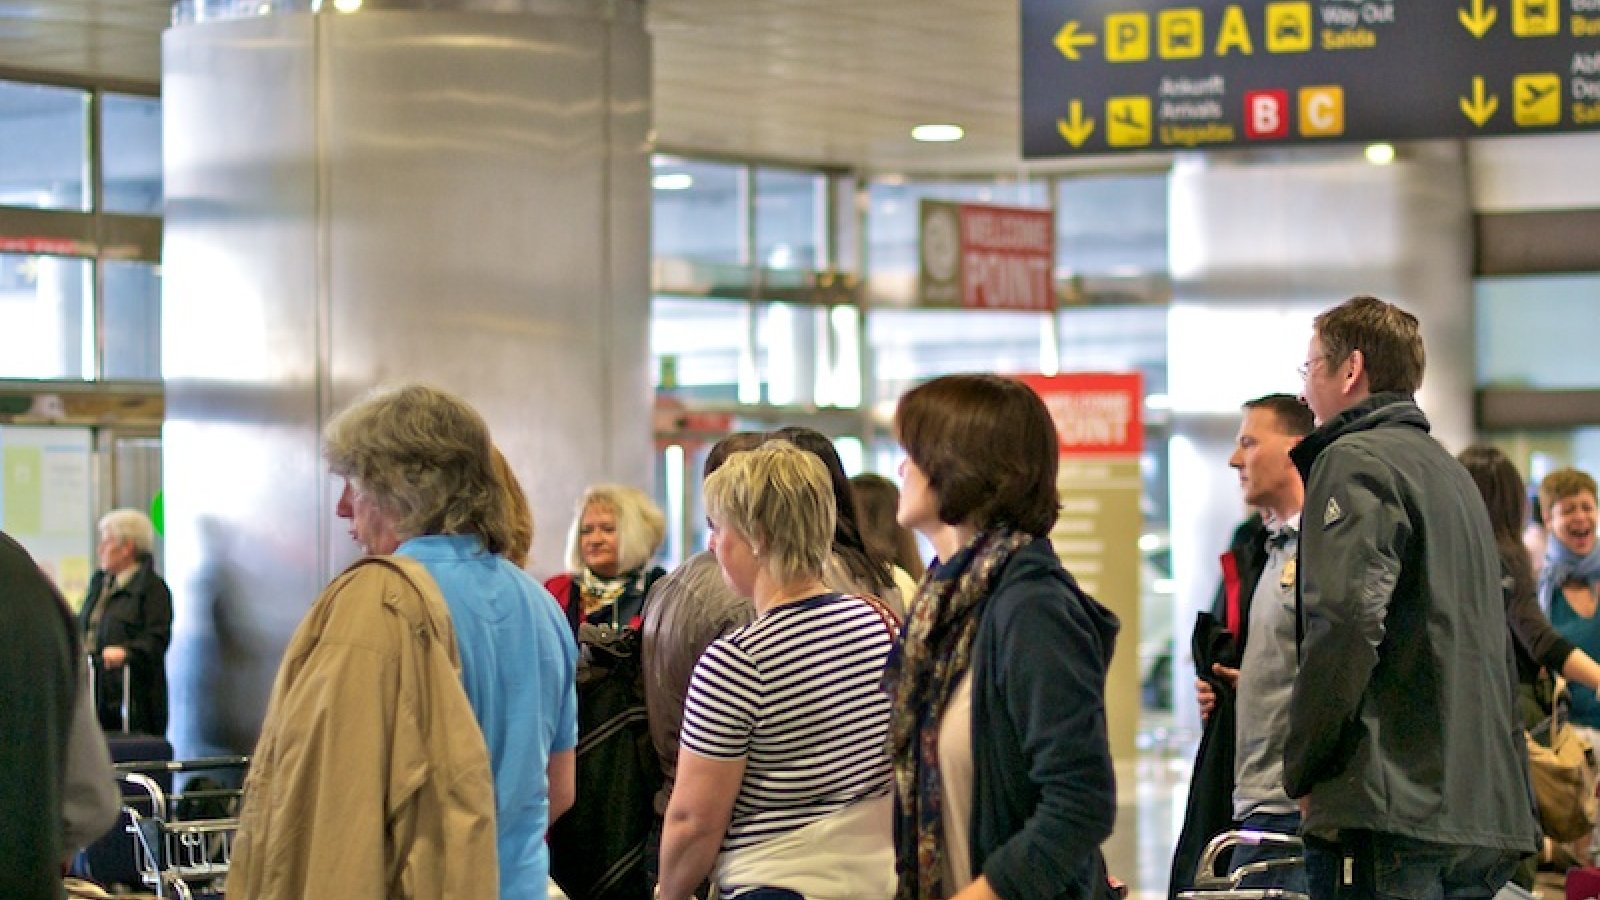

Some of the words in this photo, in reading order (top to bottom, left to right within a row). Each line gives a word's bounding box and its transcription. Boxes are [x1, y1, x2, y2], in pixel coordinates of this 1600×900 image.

[1215, 4, 1254, 57] A
[1321, 6, 1359, 28] Way
[1362, 3, 1395, 24] Out
[1321, 27, 1377, 51] Salida
[1252, 95, 1281, 134] B
[1307, 91, 1335, 130] C
[963, 252, 1049, 307] POINT
